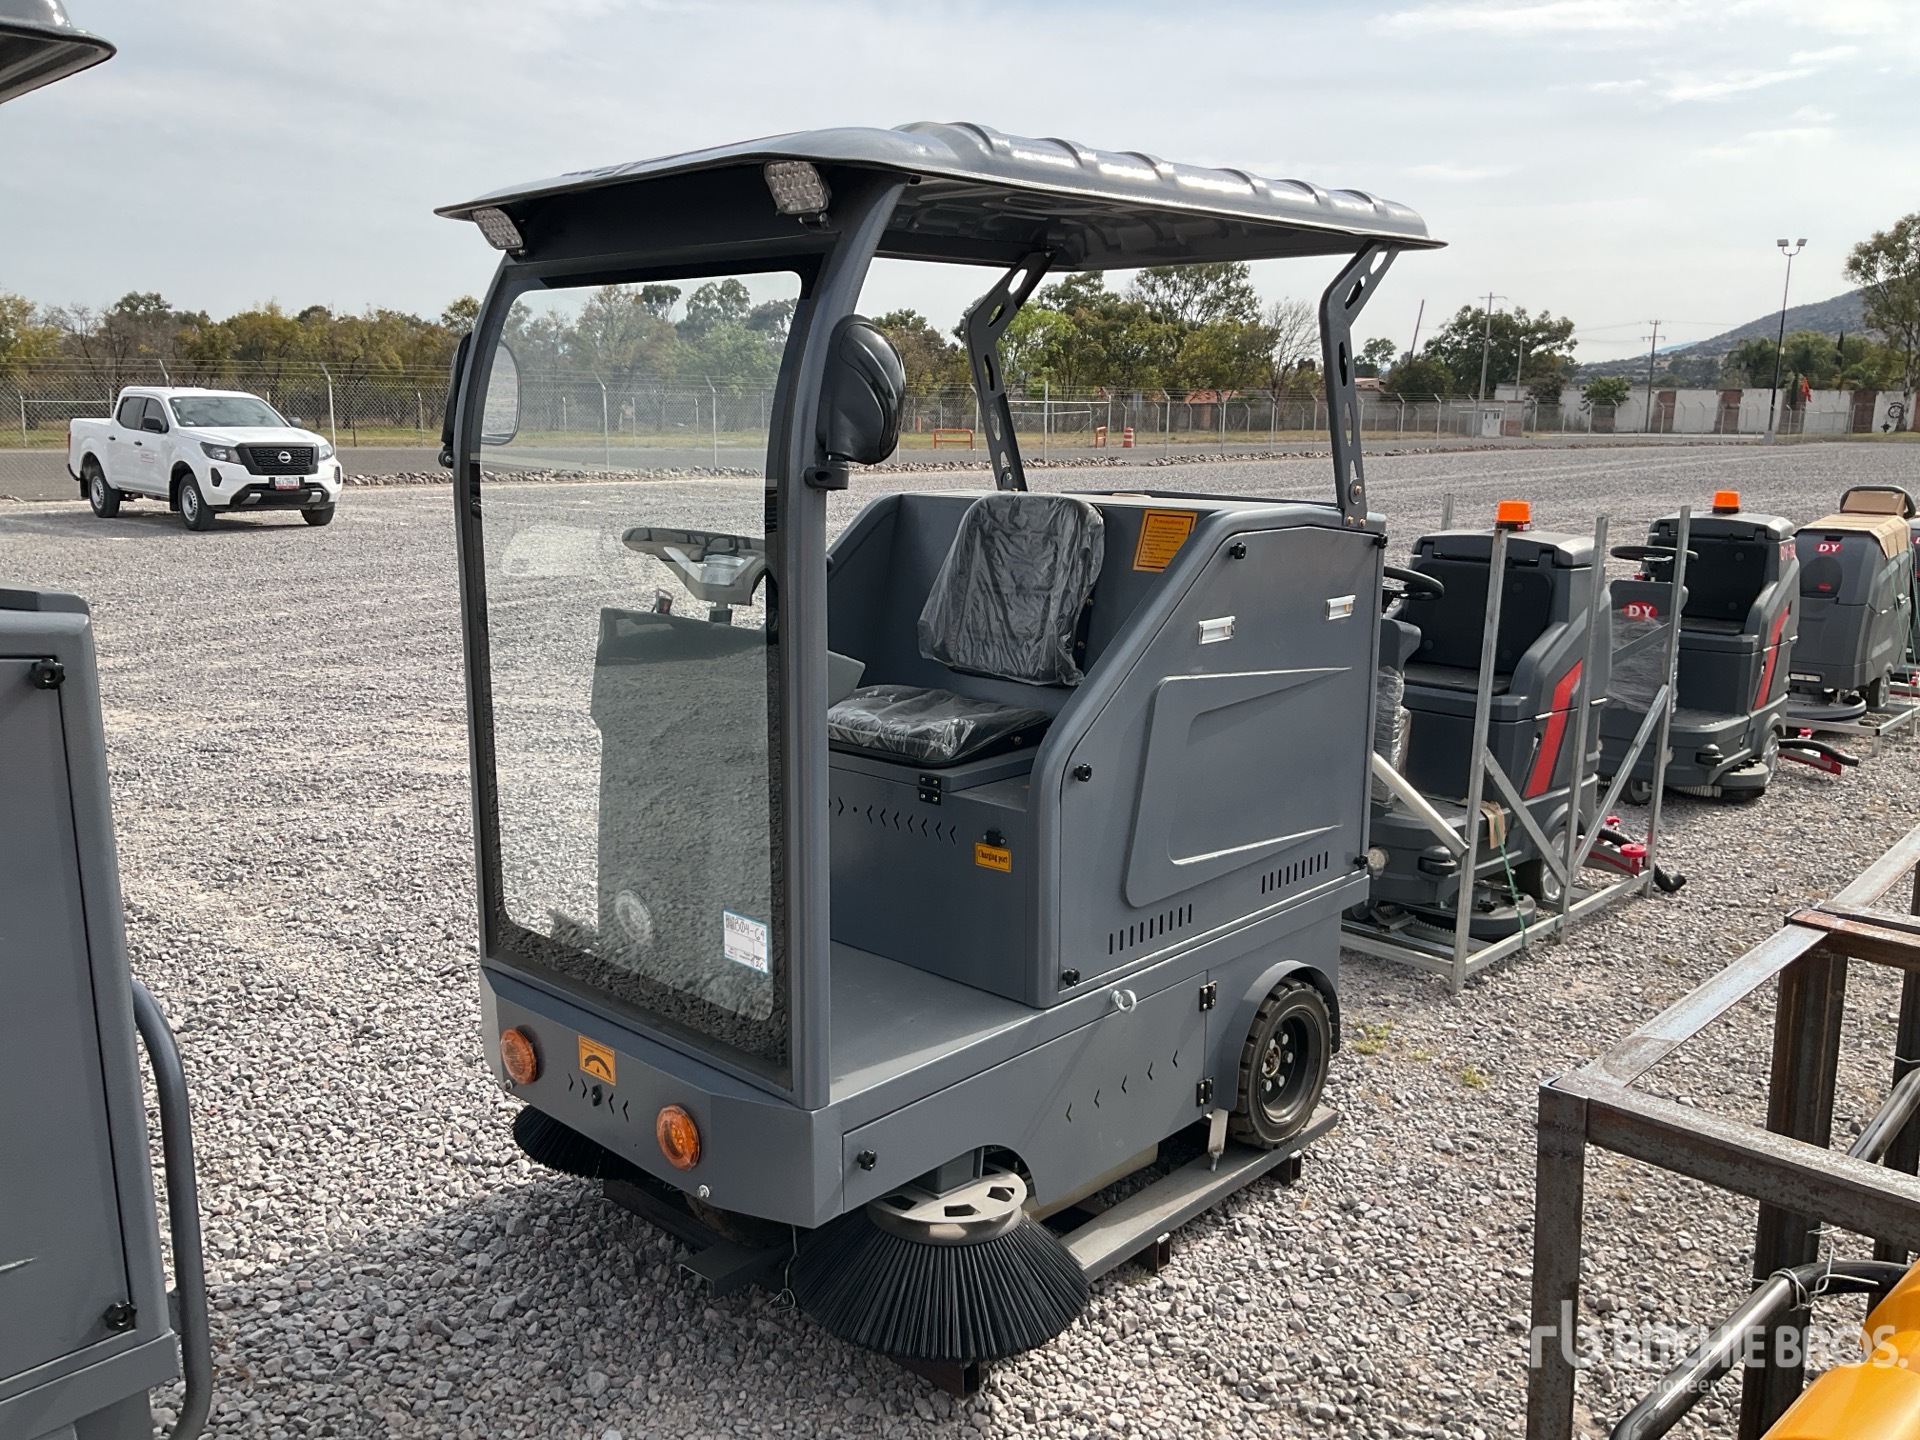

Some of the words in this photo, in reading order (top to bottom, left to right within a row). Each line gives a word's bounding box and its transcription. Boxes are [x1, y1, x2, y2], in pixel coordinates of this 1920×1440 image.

[1819, 544, 1840, 553] DY
[1628, 605, 1653, 618] DY
[978, 850, 998, 862] Charging
